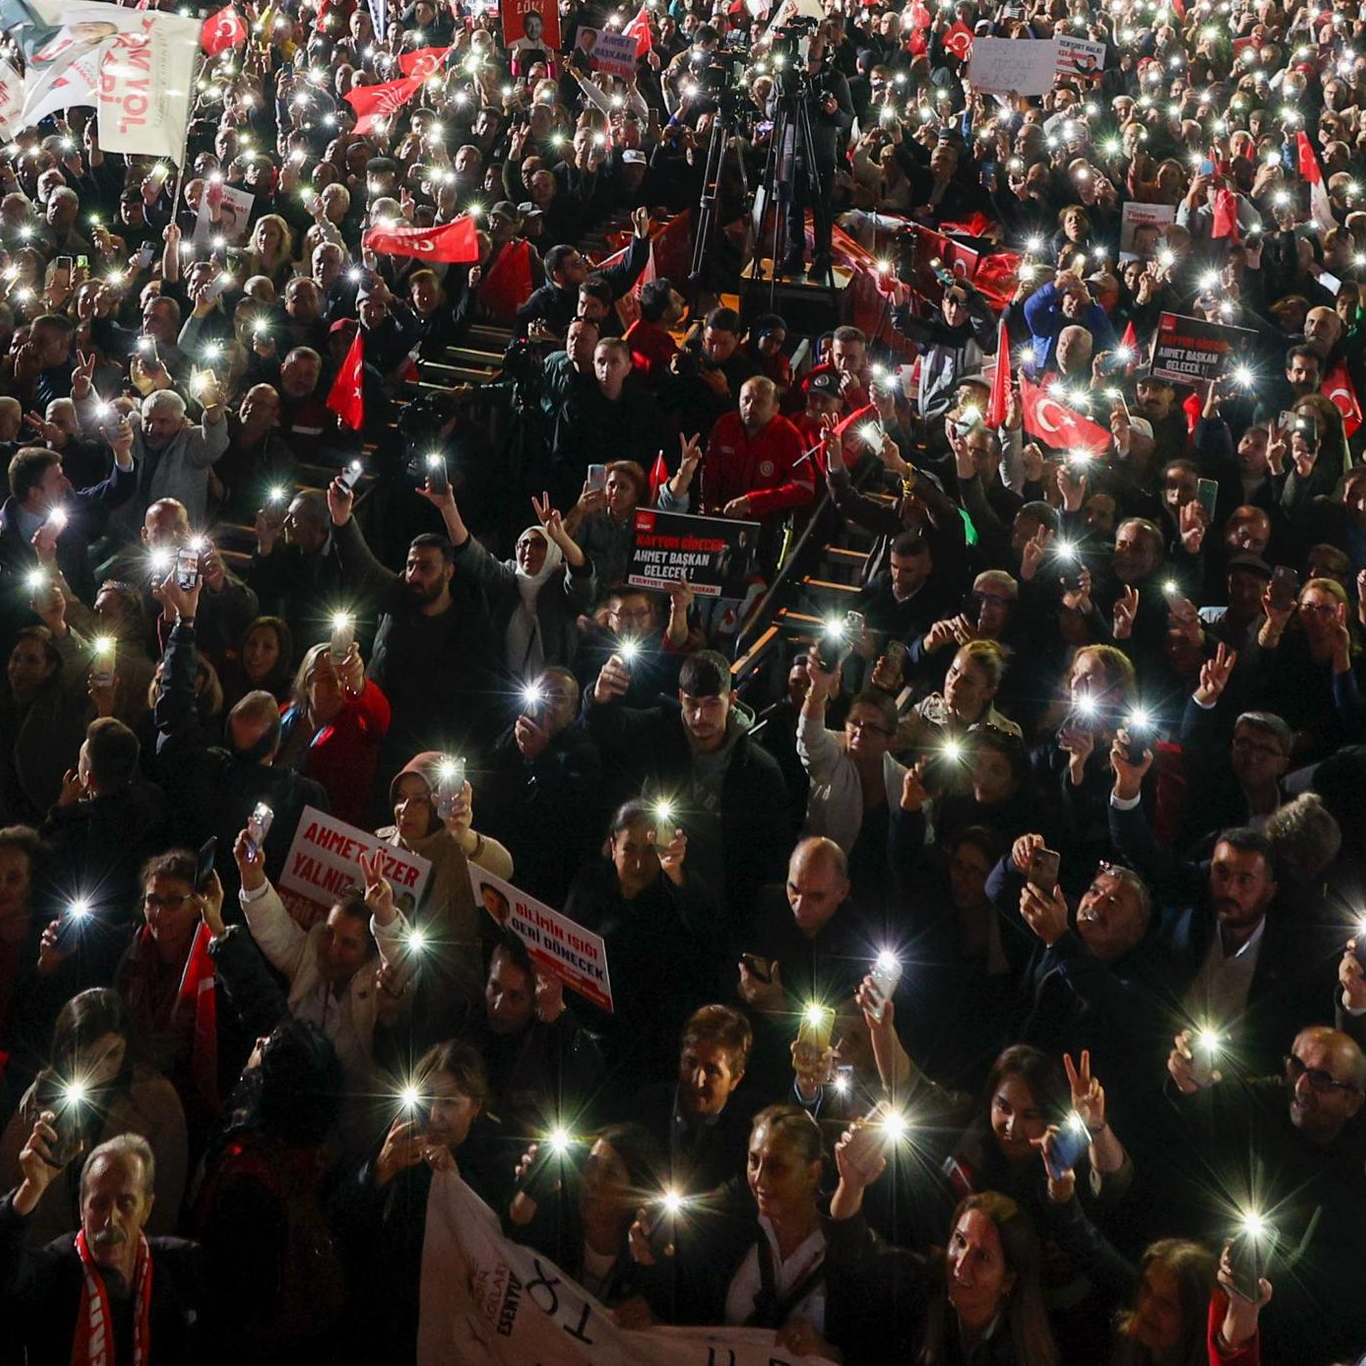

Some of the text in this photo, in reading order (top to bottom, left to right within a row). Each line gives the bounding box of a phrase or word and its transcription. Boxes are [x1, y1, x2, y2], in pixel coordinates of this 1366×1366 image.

[119, 78, 151, 135] YOL
[1166, 360, 1200, 374] GELECEK
[1186, 349, 1218, 364] BAŞKAN
[634, 549, 710, 568] AHMET BAŞKAN
[643, 564, 688, 580] GELECEK
[303, 821, 368, 865] AHMET
[291, 851, 356, 899] YALNIZ
[544, 937, 605, 982] DÖNECEK
[566, 932, 598, 960] IŞIĞI
